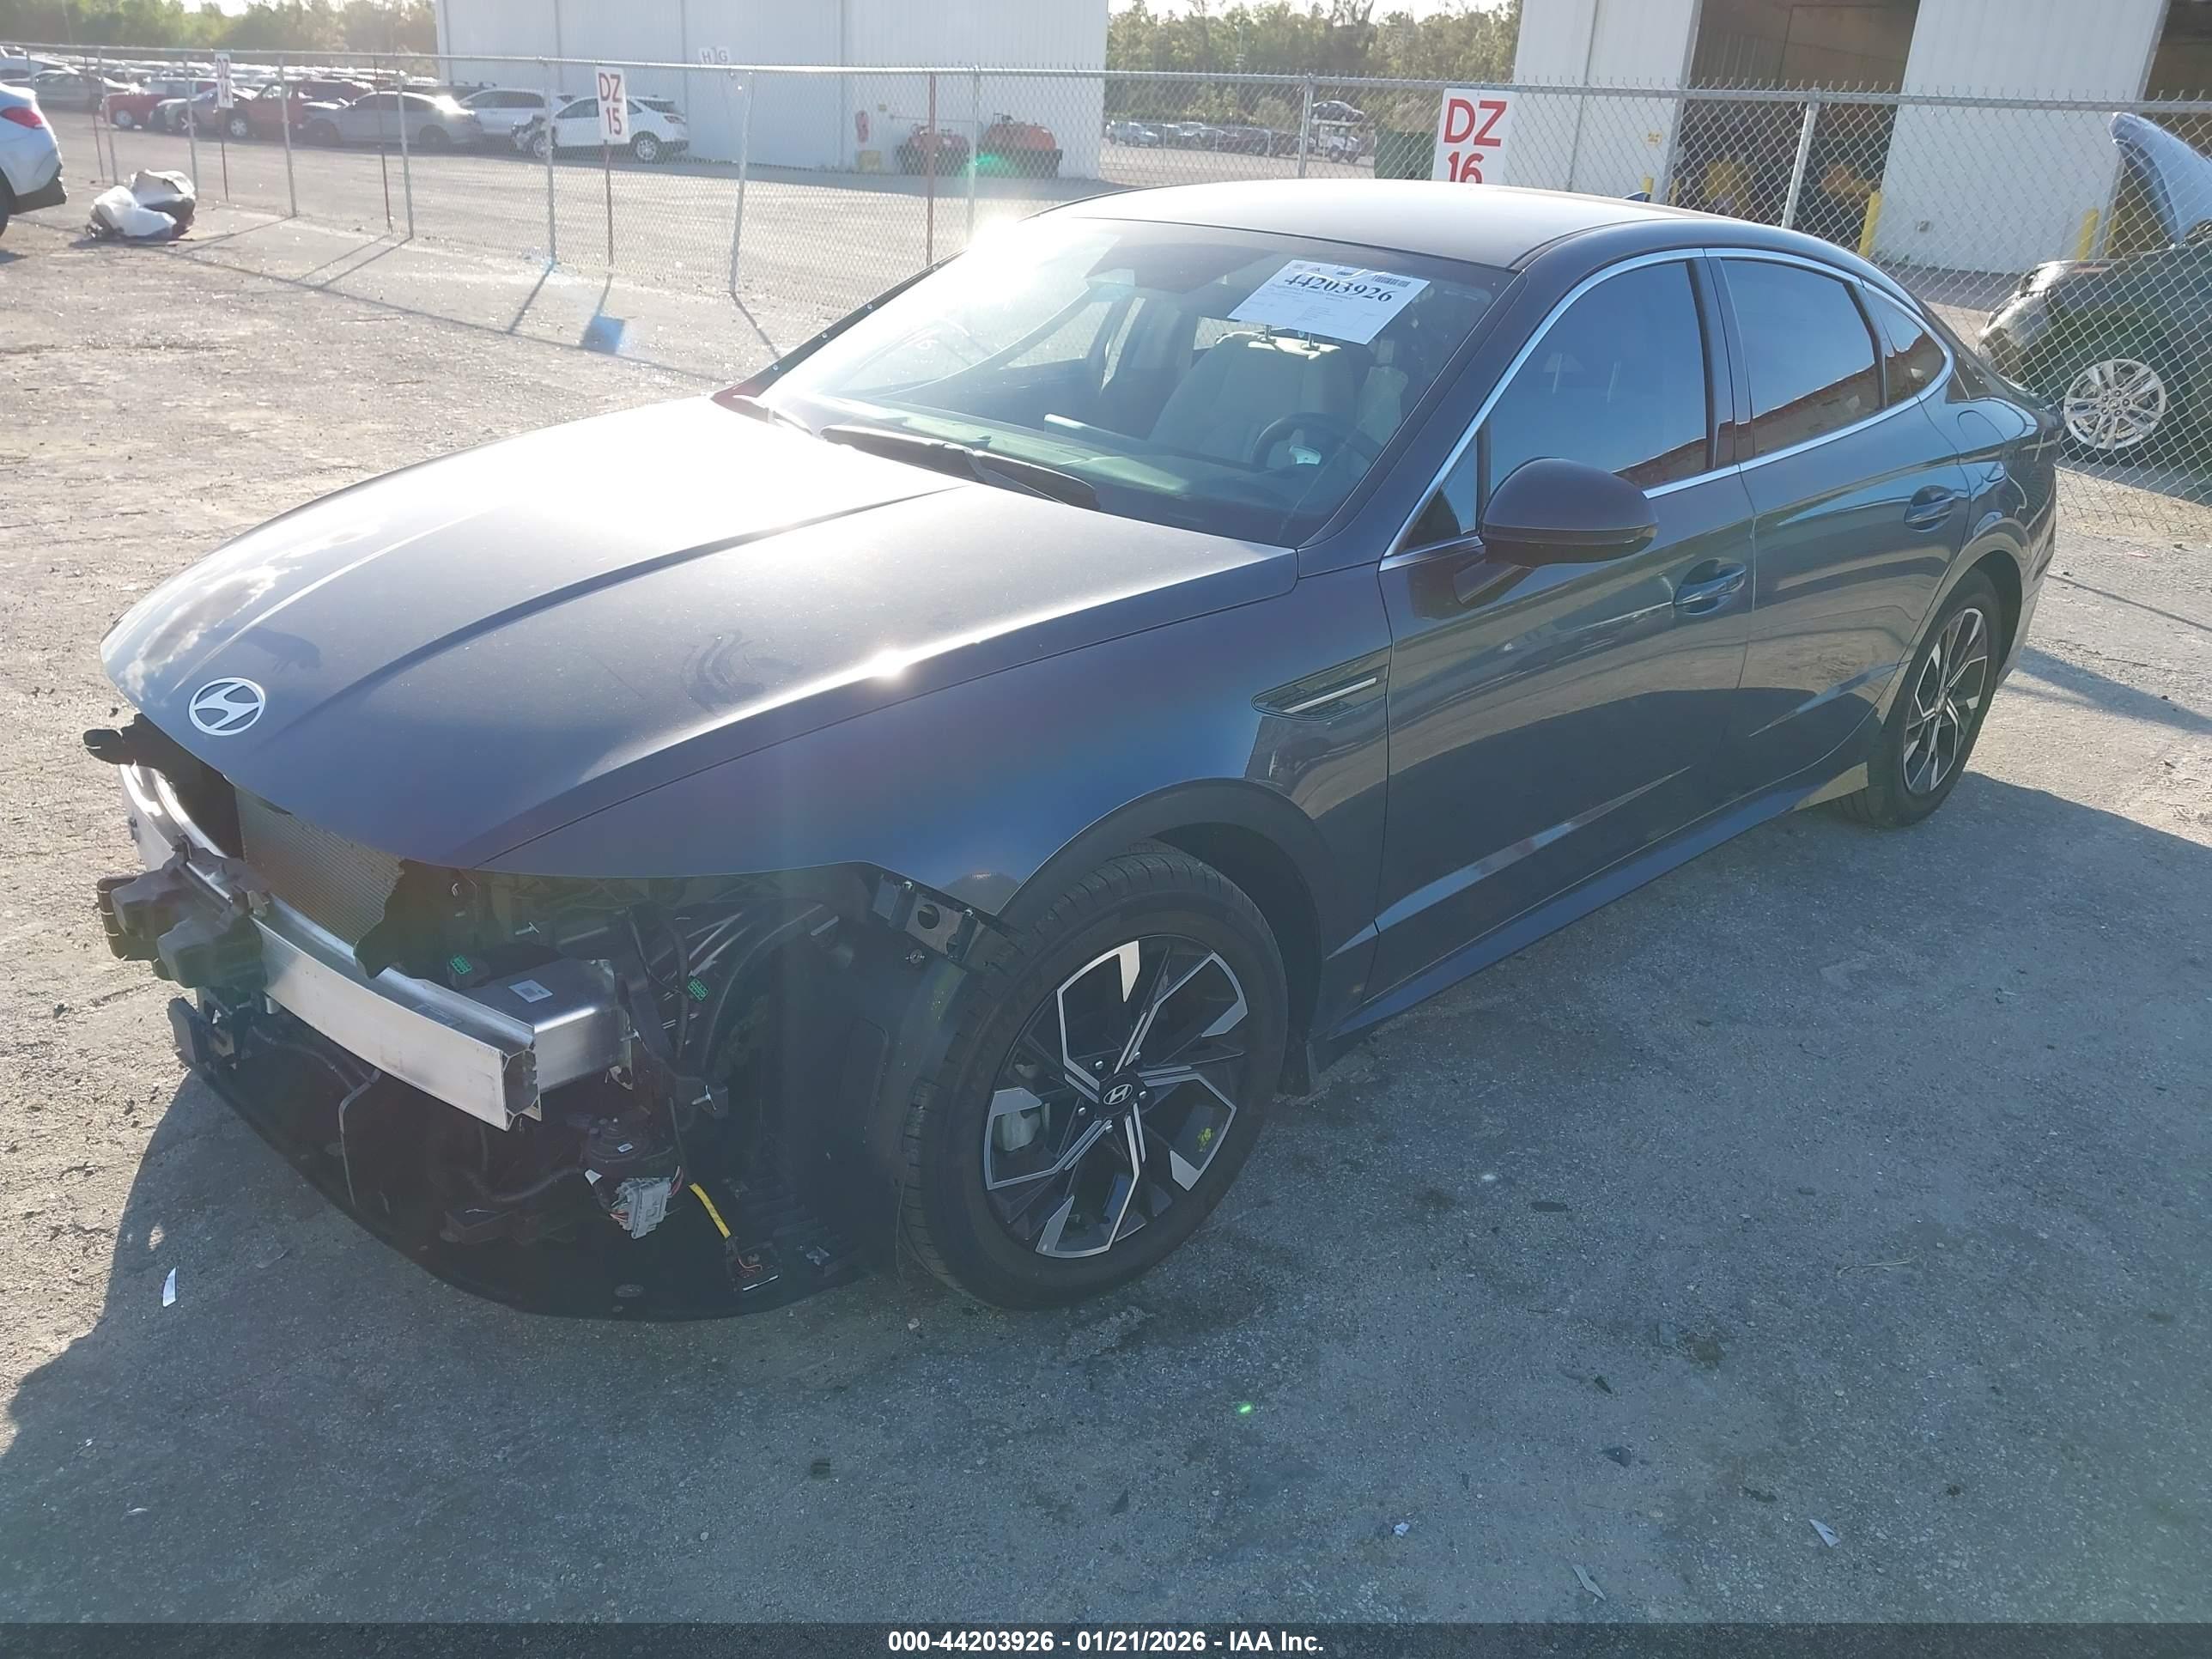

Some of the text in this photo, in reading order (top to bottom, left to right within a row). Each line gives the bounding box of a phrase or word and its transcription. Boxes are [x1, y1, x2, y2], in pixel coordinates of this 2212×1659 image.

[599, 72, 623, 103] DZ
[605, 106, 623, 135] 15
[1443, 98, 1508, 148] DZ
[1448, 151, 1485, 185] 16
[1285, 273, 1395, 302] 44203926
